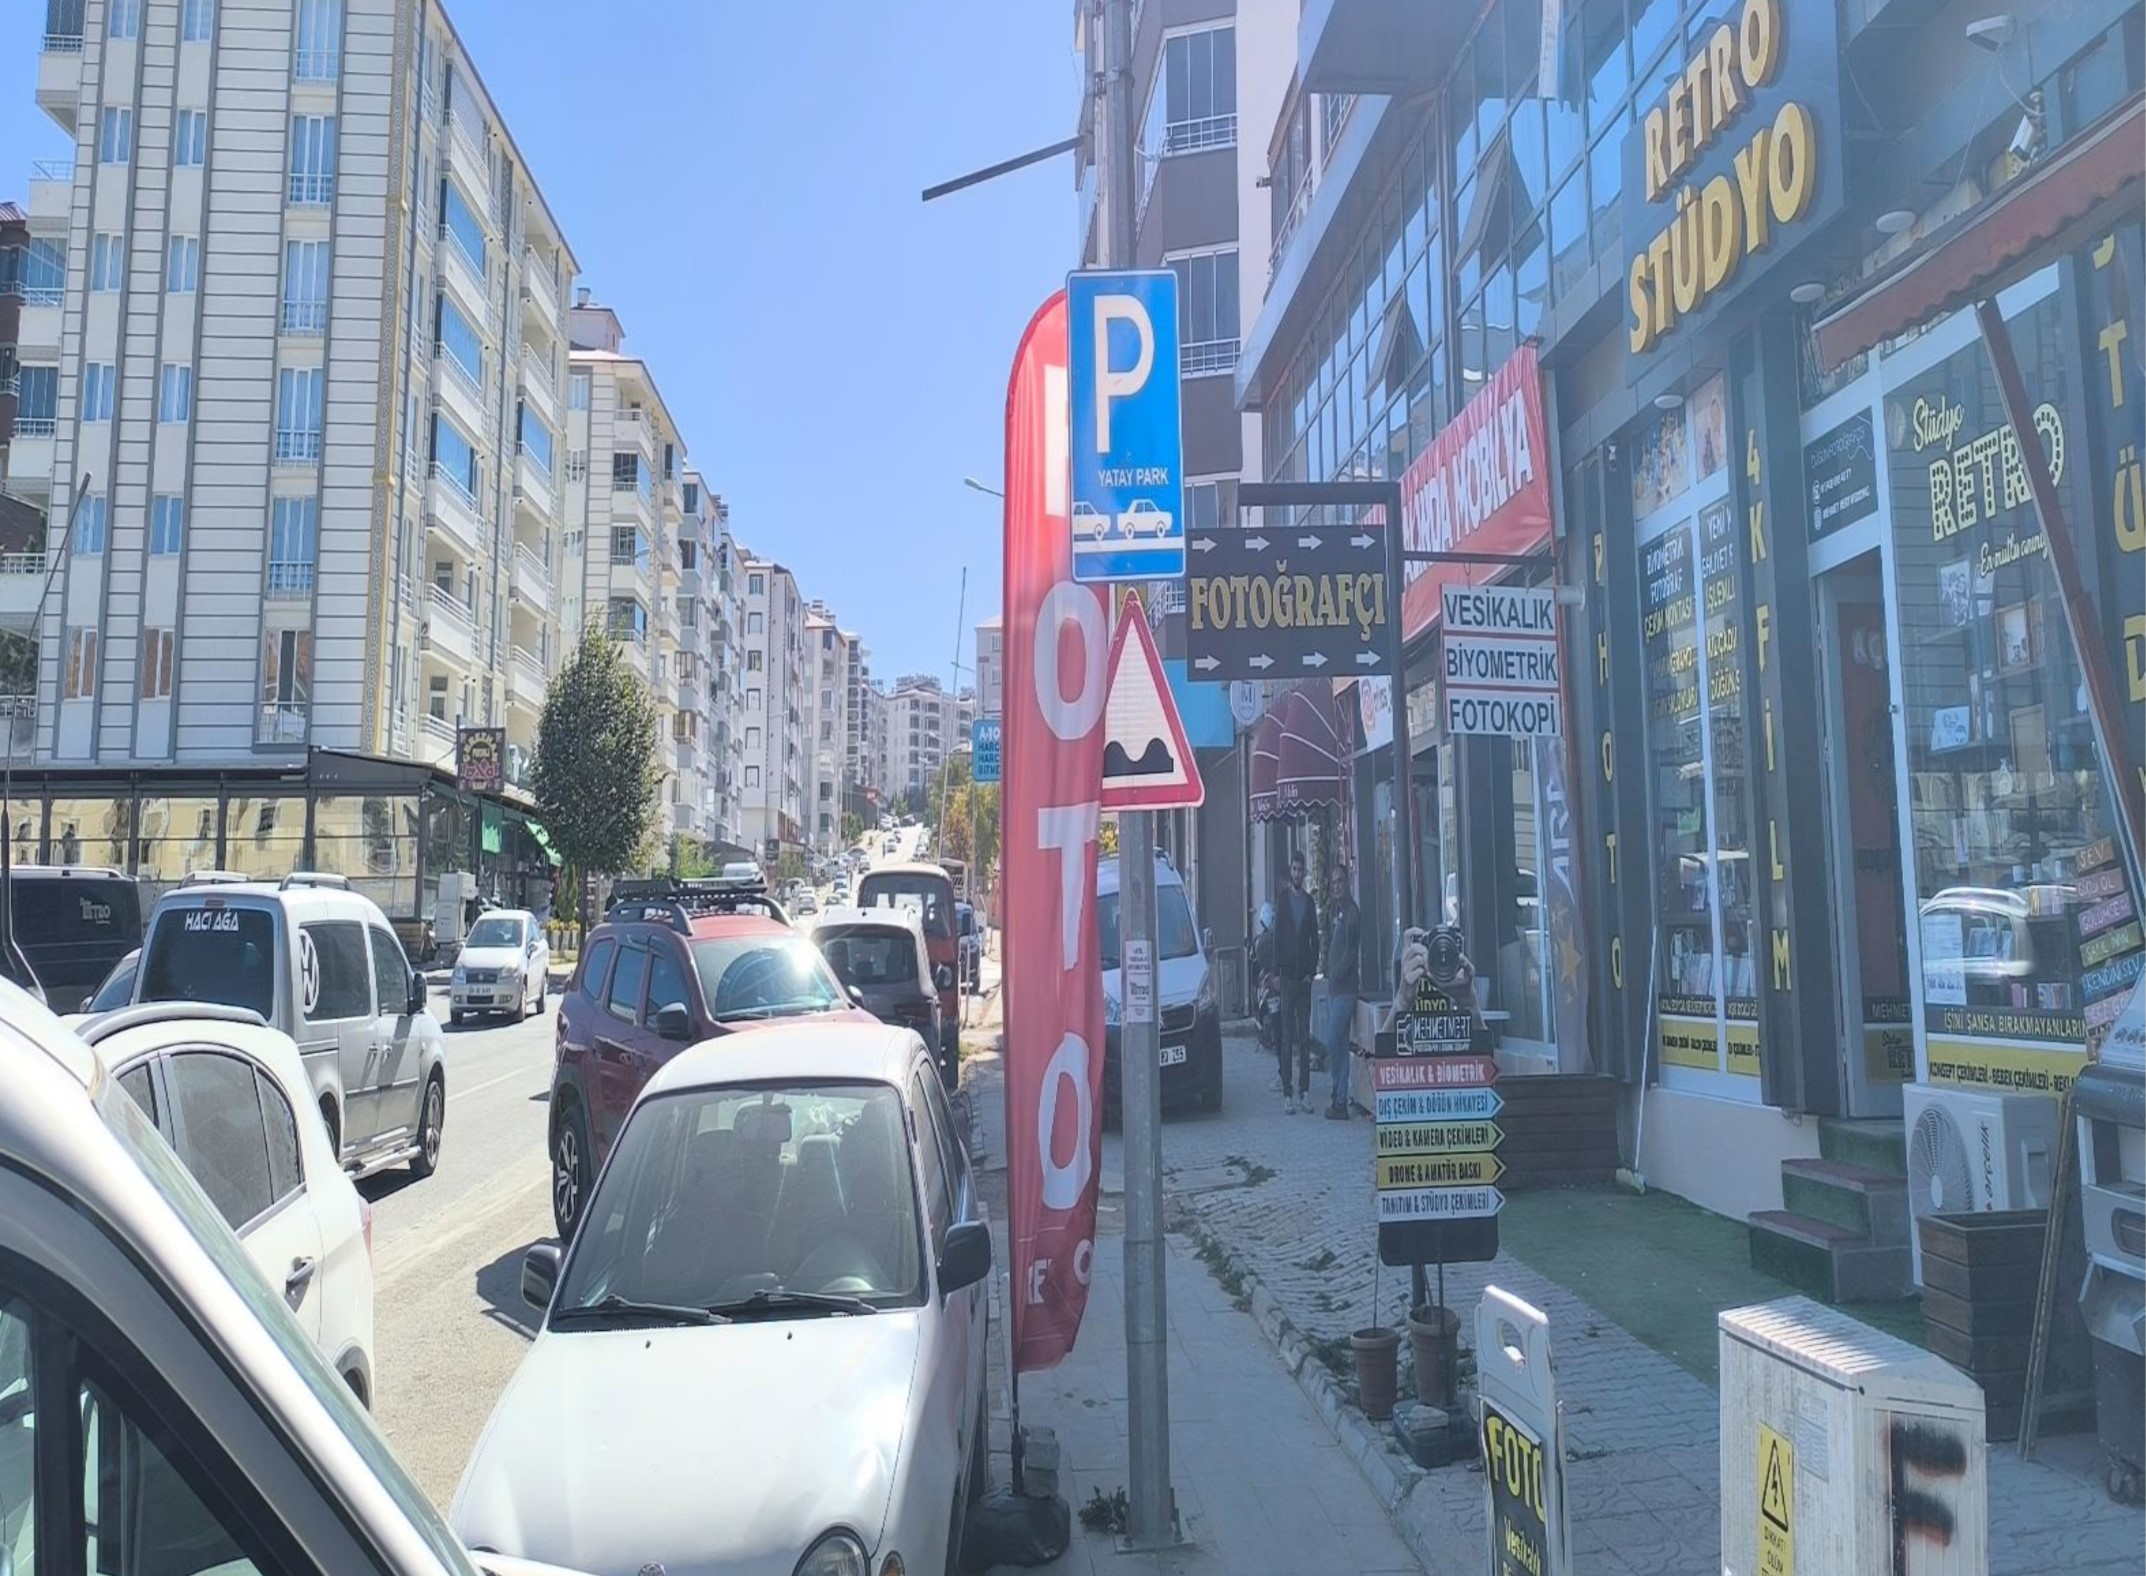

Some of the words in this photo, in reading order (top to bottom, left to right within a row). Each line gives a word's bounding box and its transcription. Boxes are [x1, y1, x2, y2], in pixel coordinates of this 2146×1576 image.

[1644, 0, 1781, 203] RETRO
[1630, 101, 1816, 354] STÜDYO
[1094, 294, 1155, 453] P
[1912, 396, 1965, 452] Stüdyo
[1098, 467, 1133, 488] YATAY
[1136, 466, 1169, 486] PARK
[1190, 559, 1386, 642] FOTOĞRAFÇI
[1444, 588, 1554, 631] VESİKALIK
[1446, 642, 1558, 682] BİYOMETRİK
[1449, 695, 1556, 734] FOTOKOPİ
[184, 911, 213, 932] HACI
[212, 908, 239, 932] AĞA
[1872, 1003, 1913, 1019] MEHME
[1966, 1012, 1996, 1035] ŞANSA
[1998, 1014, 2088, 1039] BIRAKMAYANLARIN
[1414, 1015, 1448, 1039] MEHMET
[1380, 1062, 1426, 1085] VESİKALIK
[1437, 1060, 1485, 1084] BİOMETRİK
[1992, 1067, 2013, 1085] BEBEK
[2053, 1073, 2078, 1093] REKLA
[1394, 1093, 1417, 1119] ÇEKİM
[1453, 1090, 1488, 1113] HİKAYESİ
[1379, 1126, 1403, 1149] VİDEO
[1413, 1128, 1445, 1148] KAMERA
[1447, 1122, 1489, 1150] ÇEKİMLERİ
[1389, 1163, 1416, 1184] DRONE
[1425, 1159, 1456, 1183] AMATÖR
[1459, 1162, 1481, 1180] BASKI
[1382, 1195, 1412, 1215] TANITIM
[1422, 1190, 1449, 1214] STÜDYO
[1451, 1188, 1489, 1217] ÇEKİMLERİ
